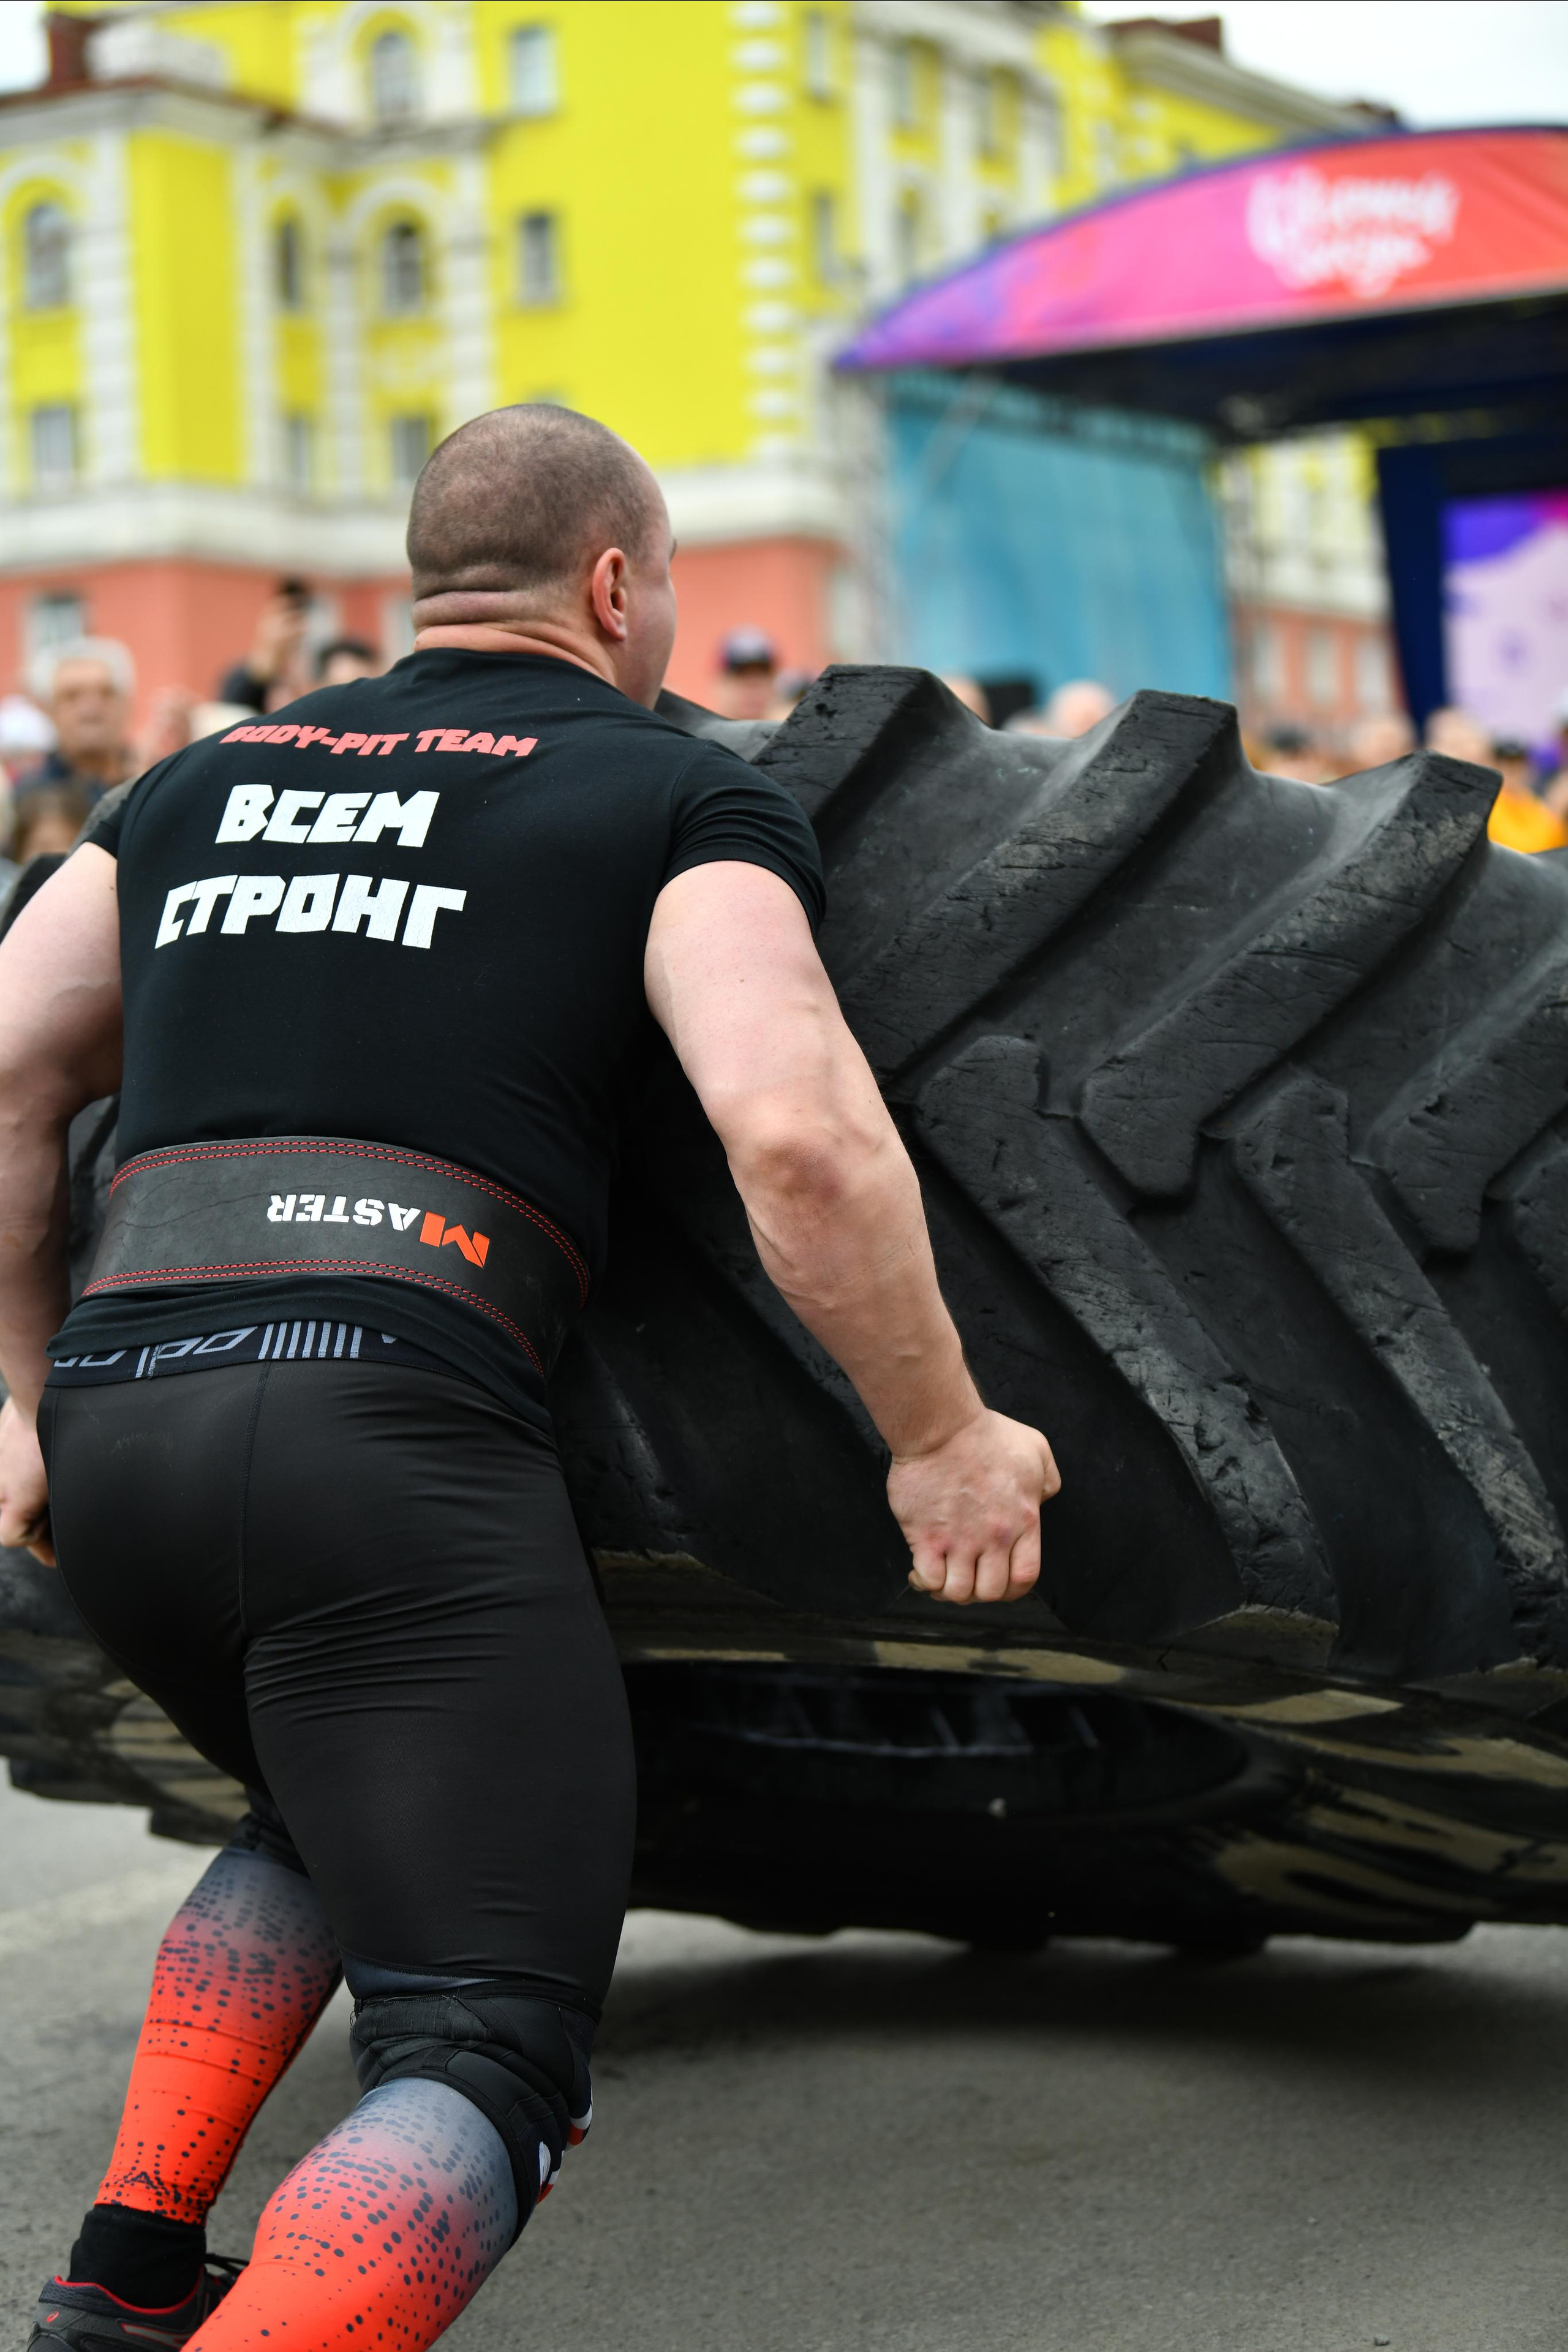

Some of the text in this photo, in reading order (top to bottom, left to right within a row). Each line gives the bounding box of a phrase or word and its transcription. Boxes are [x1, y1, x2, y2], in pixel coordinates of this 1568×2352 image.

[220, 725, 538, 756] BODY-PIT TEAM
[215, 784, 440, 847] ВСЕМ
[155, 873, 467, 949] СТРОНГ
[267, 1194, 489, 1268] MASTER
